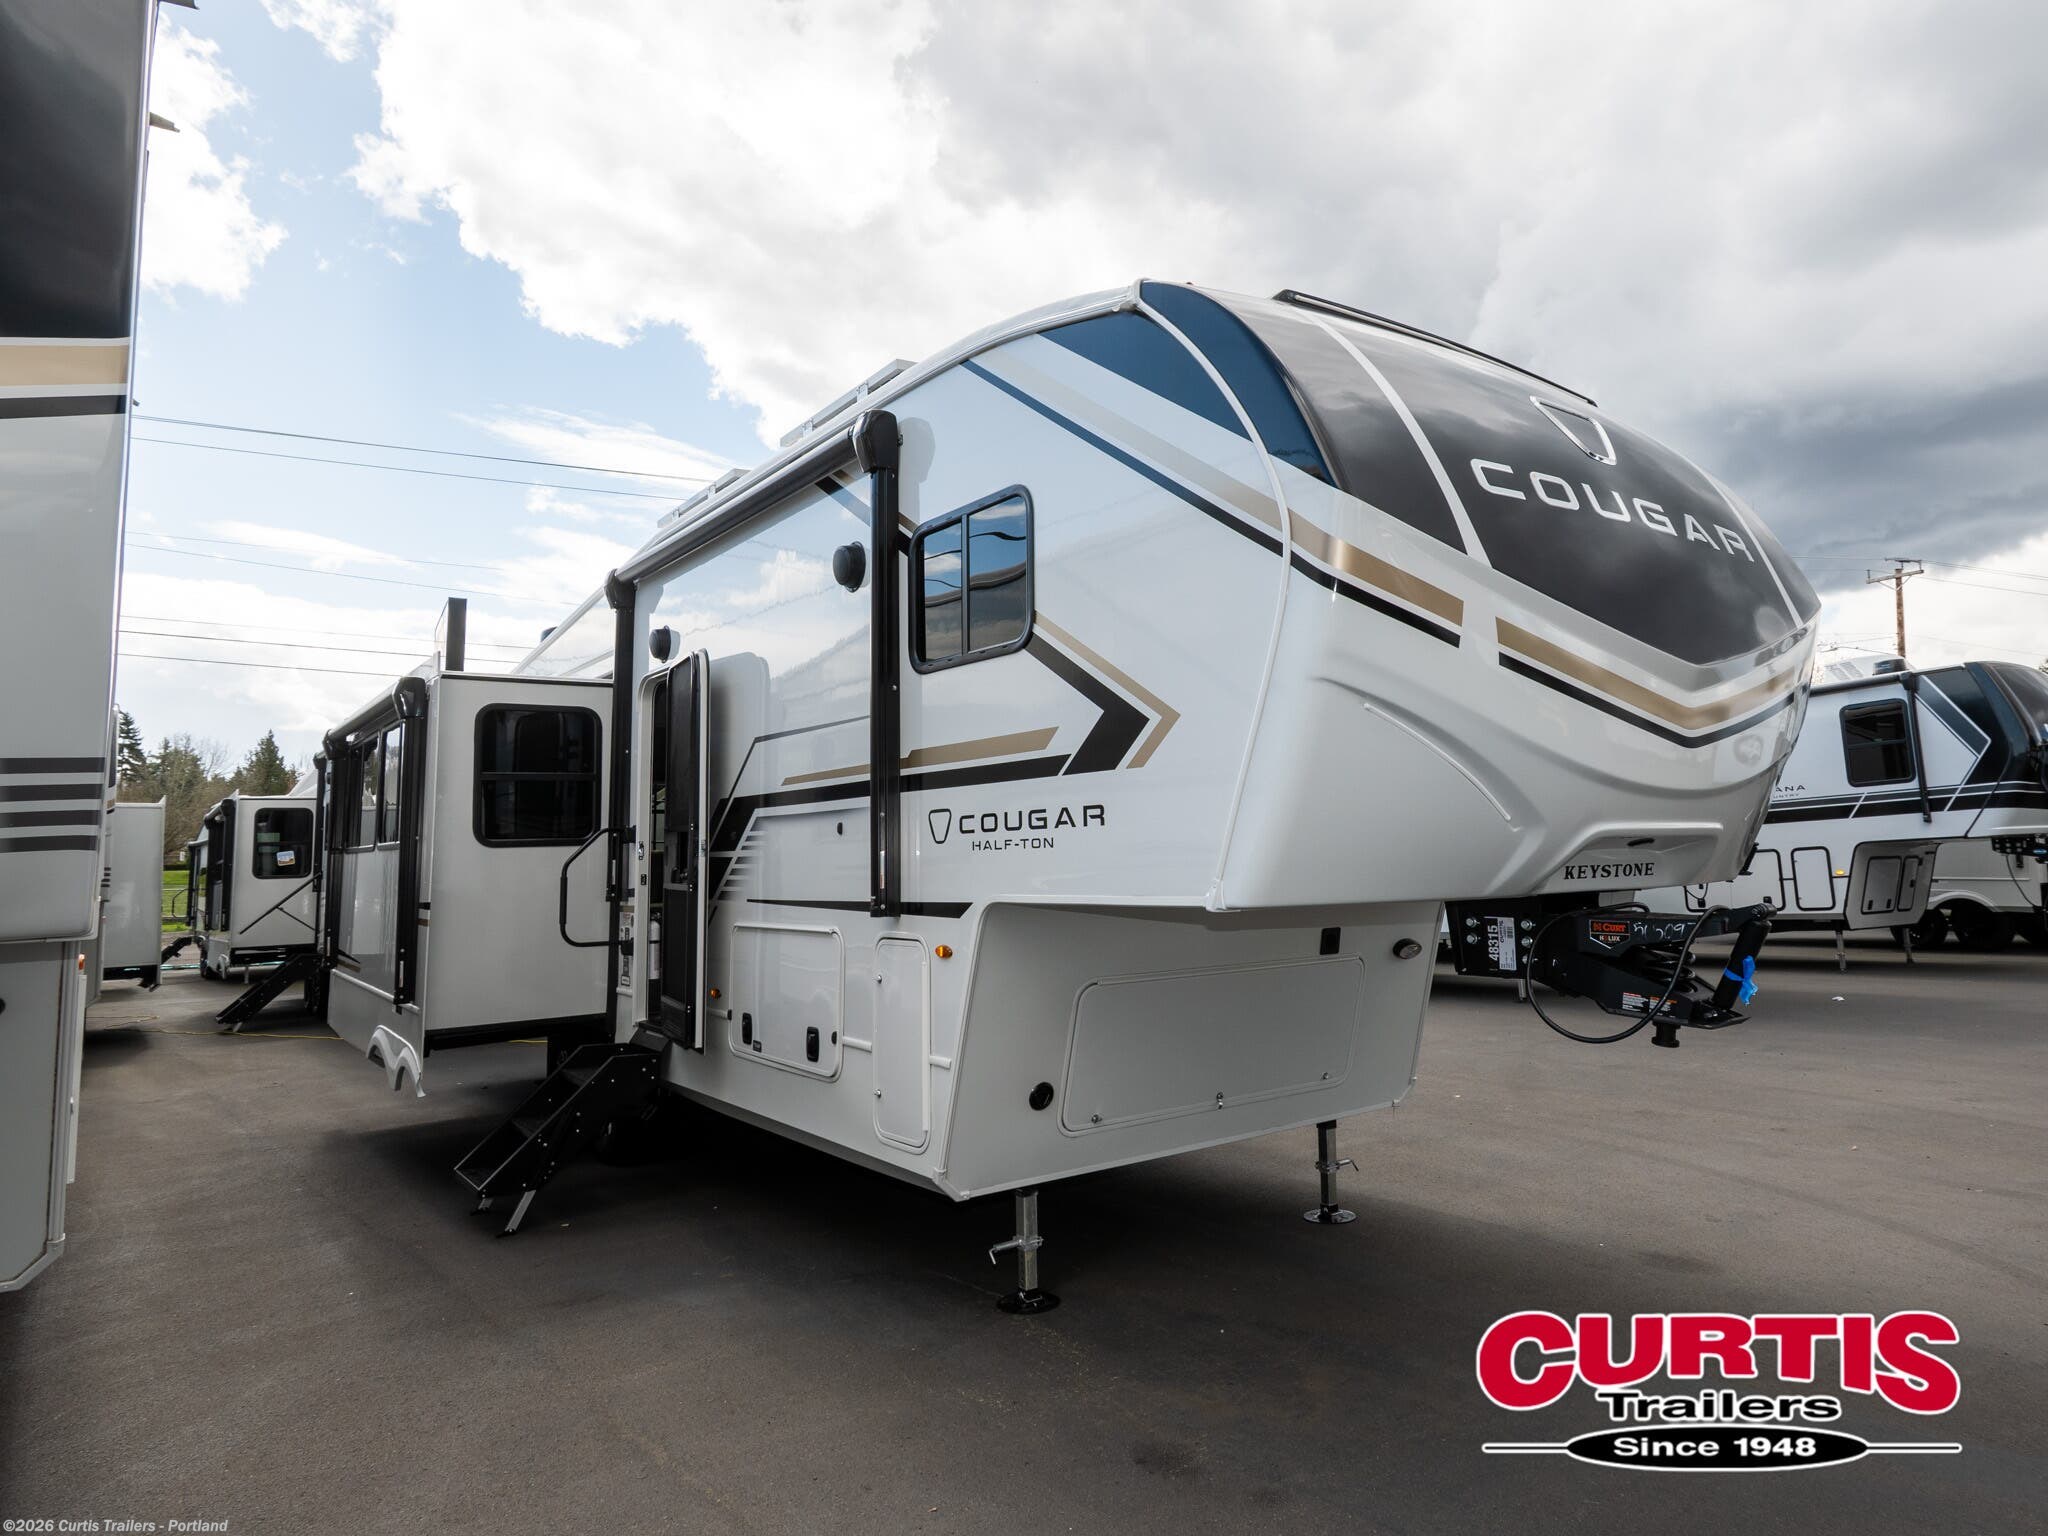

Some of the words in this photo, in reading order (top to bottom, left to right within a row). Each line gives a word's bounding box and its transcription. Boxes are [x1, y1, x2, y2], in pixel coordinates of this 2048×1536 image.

[1470, 458, 1755, 562] COUGAR
[959, 804, 1105, 834] COUGAR
[972, 837, 1054, 851] HALF-TON
[1564, 862, 1655, 880] KEYSTONE
[1487, 925, 1499, 961] 48315
